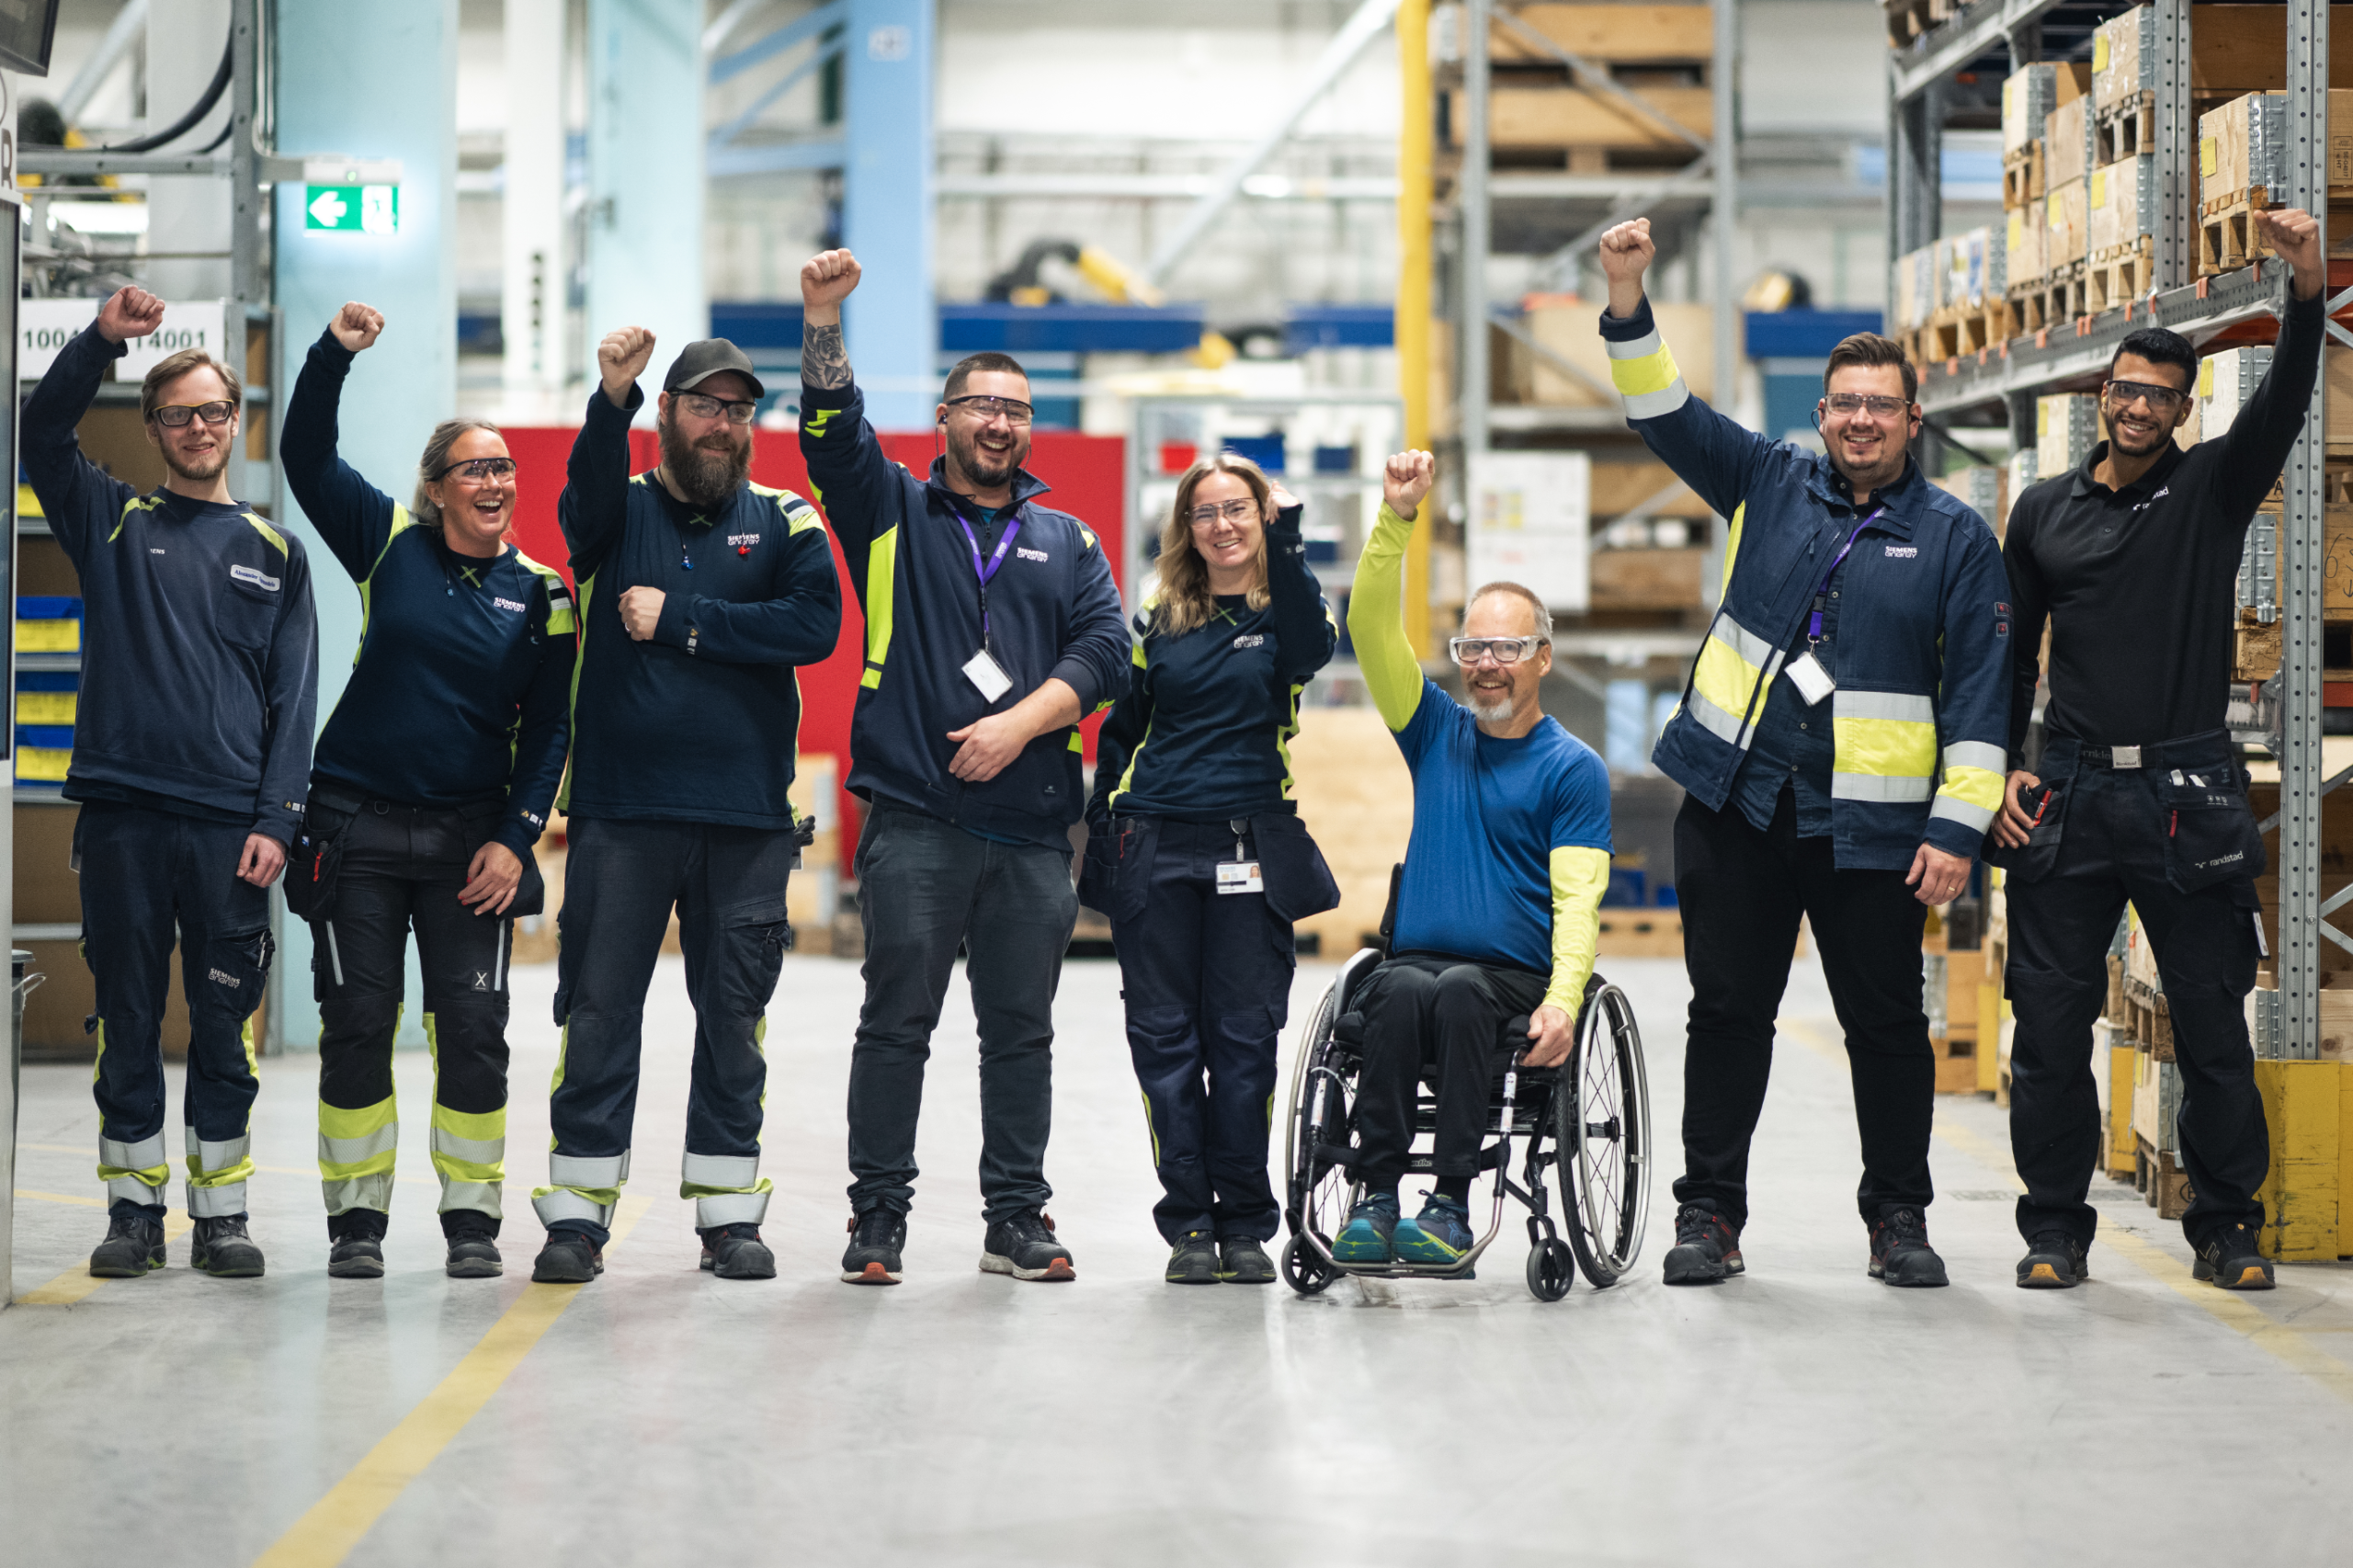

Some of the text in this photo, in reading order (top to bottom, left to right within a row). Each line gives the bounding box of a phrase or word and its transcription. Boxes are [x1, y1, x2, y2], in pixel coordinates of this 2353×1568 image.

[1017, 547, 1049, 559] SIEMENS
[1885, 545, 1917, 553] SIEMENS
[494, 597, 526, 608] SIEMENS
[2210, 850, 2245, 867] randstad
[210, 968, 241, 984] SIEMENS
